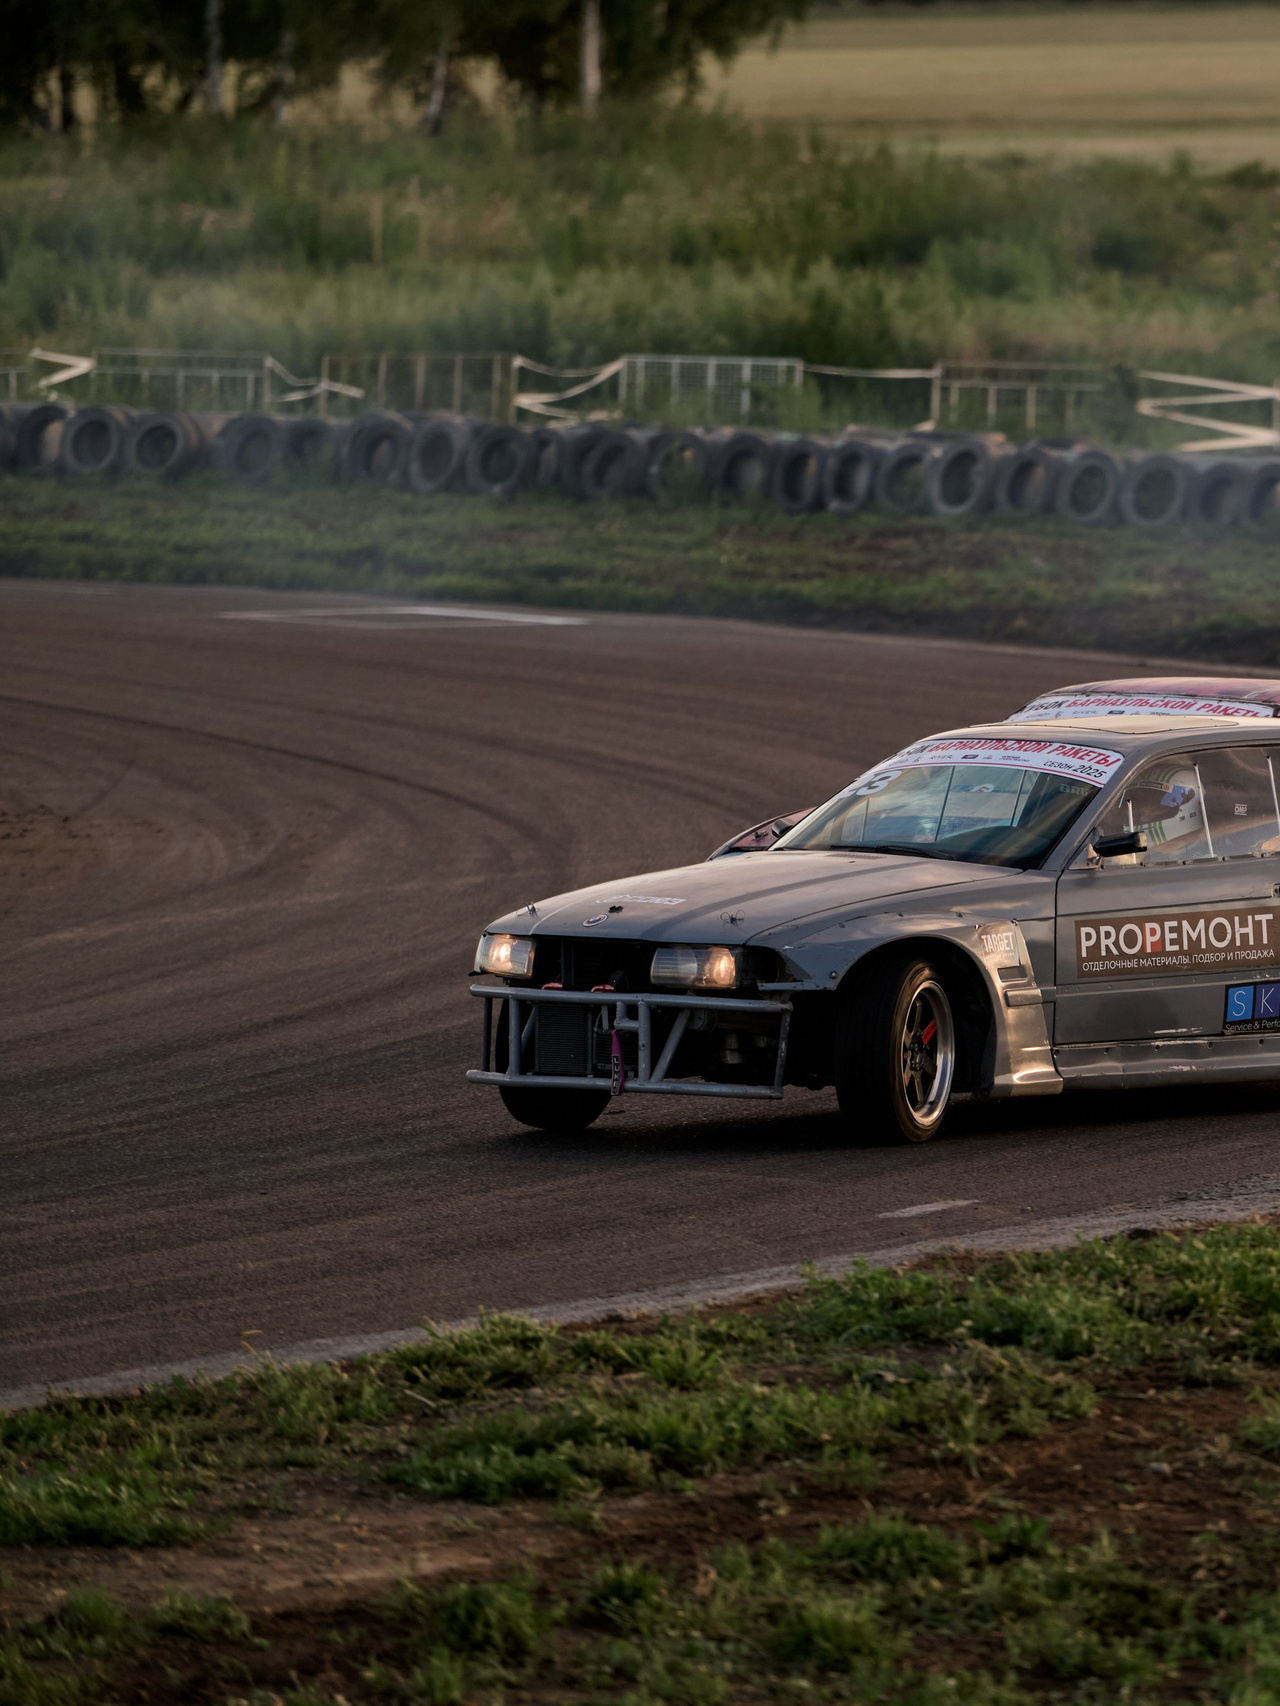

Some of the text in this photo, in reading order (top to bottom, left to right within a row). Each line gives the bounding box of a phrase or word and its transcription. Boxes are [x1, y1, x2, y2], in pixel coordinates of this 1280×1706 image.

[1066, 697, 1197, 712] БАРНАУЛЬСКОЙ
[927, 739, 1053, 756] БАРНАУЛЬСКОЙ
[1046, 744, 1121, 767] РАКЕТЫ
[1043, 759, 1075, 771] СЕЗОН
[1072, 764, 1107, 778] 2025
[1234, 804, 1248, 815] OMP
[981, 931, 1015, 953] TARGET
[1082, 958, 1138, 972] ОТДЕЛОЧНЫЕ
[1192, 952, 1226, 964] ПОДБОР
[1226, 952, 1234, 961] И
[1234, 948, 1275, 960] ПРОДАЖА
[1225, 1022, 1253, 1032] Service
[1253, 1021, 1261, 1030] &
